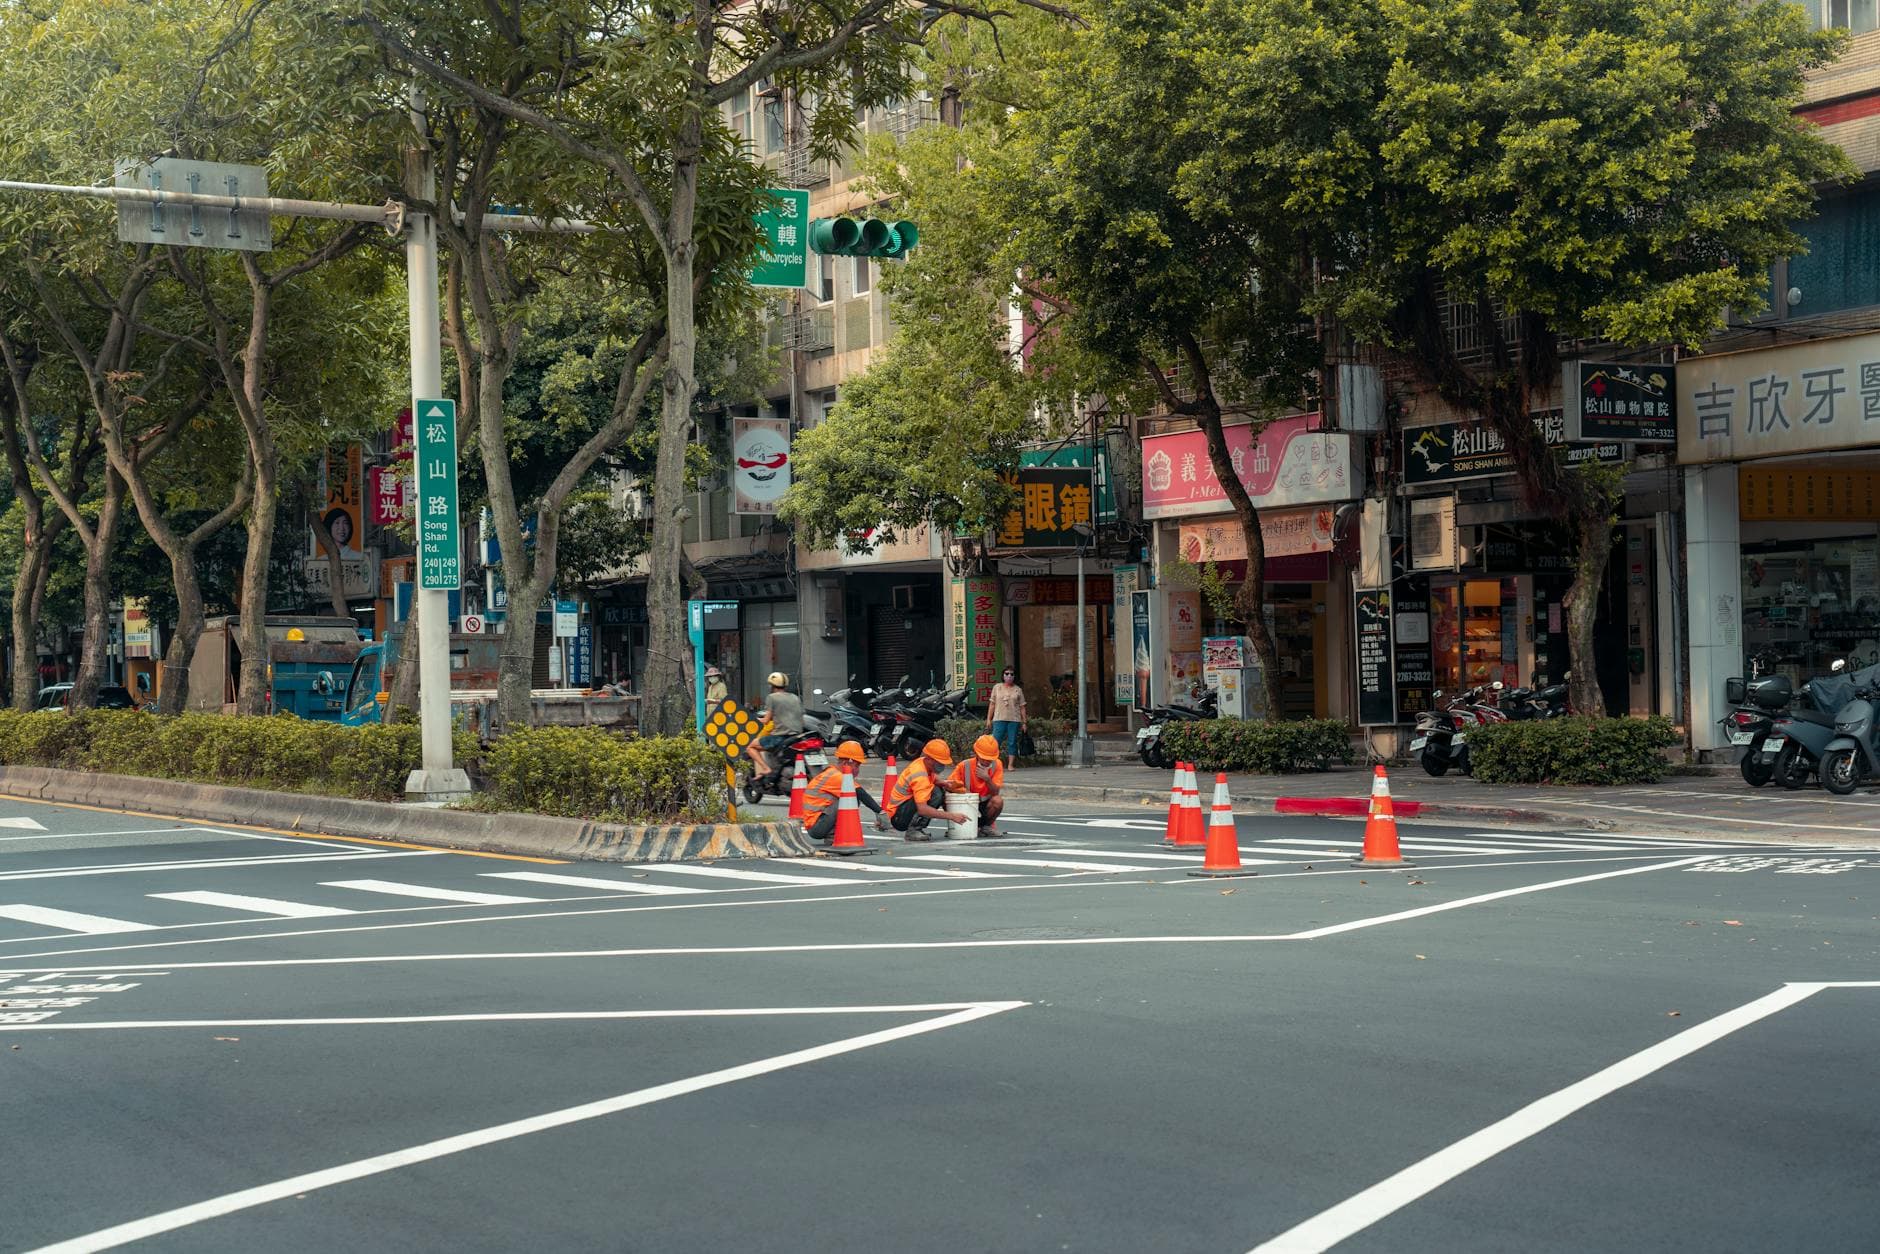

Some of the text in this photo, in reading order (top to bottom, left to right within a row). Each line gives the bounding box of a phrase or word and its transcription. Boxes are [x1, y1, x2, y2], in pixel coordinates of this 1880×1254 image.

[1585, 397, 1670, 417] 松山動物醫院
[1640, 428, 1675, 438] 2767-3322
[425, 423, 449, 516] 松山路
[1453, 460, 1474, 472] SONG
[1474, 458, 1494, 470] SHAN
[379, 472, 398, 519] 建光
[1024, 483, 1091, 532] 眼鏡
[424, 521, 448, 532] Song
[424, 532, 448, 541] Shan
[424, 543, 440, 553] Rd.
[424, 558, 439, 567] 240
[442, 558, 457, 567] 249
[425, 575, 440, 585] 290
[443, 575, 458, 585] 275
[1116, 574, 1125, 607] 全功能
[1397, 672, 1431, 682] 2767-3322
